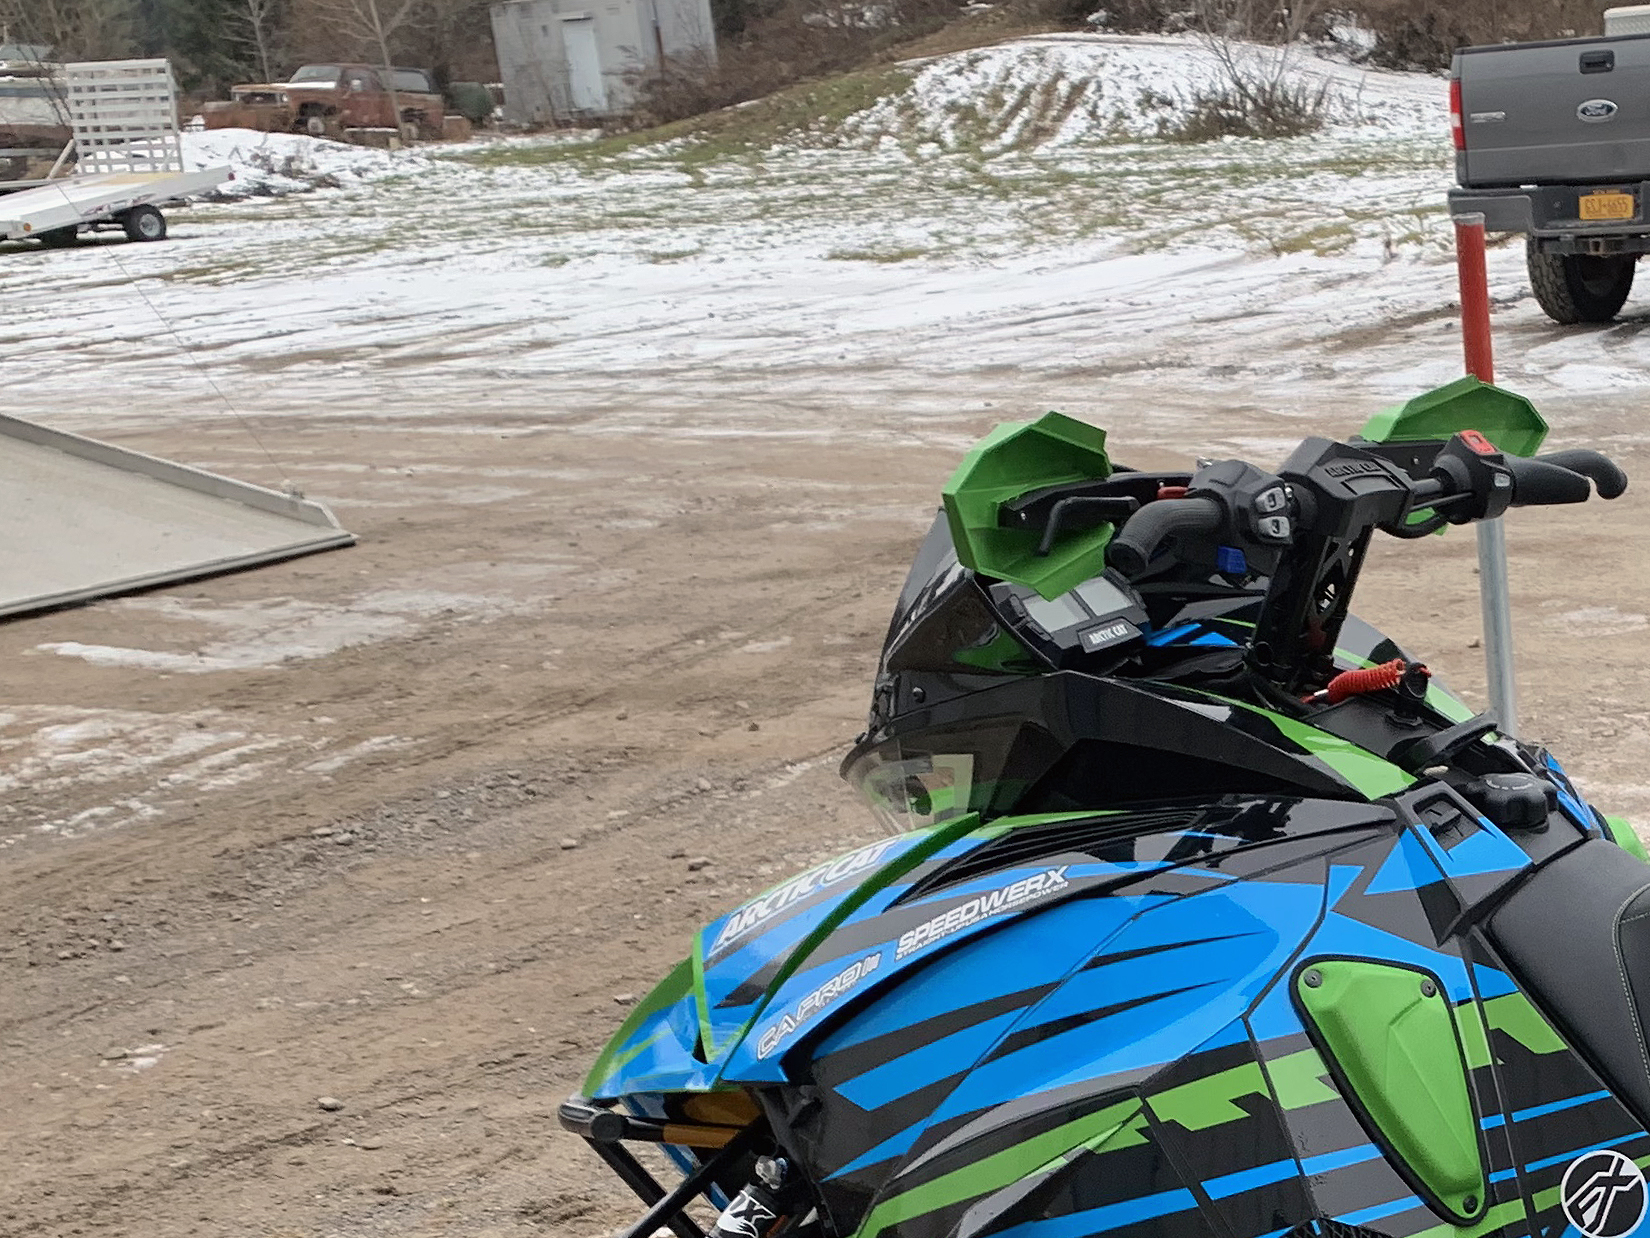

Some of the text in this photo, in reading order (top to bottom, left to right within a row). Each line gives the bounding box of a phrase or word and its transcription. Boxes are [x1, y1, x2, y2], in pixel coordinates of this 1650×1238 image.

[715, 839, 897, 946] ARCTIC CAT
[897, 865, 1069, 949] SPEEDWERX
